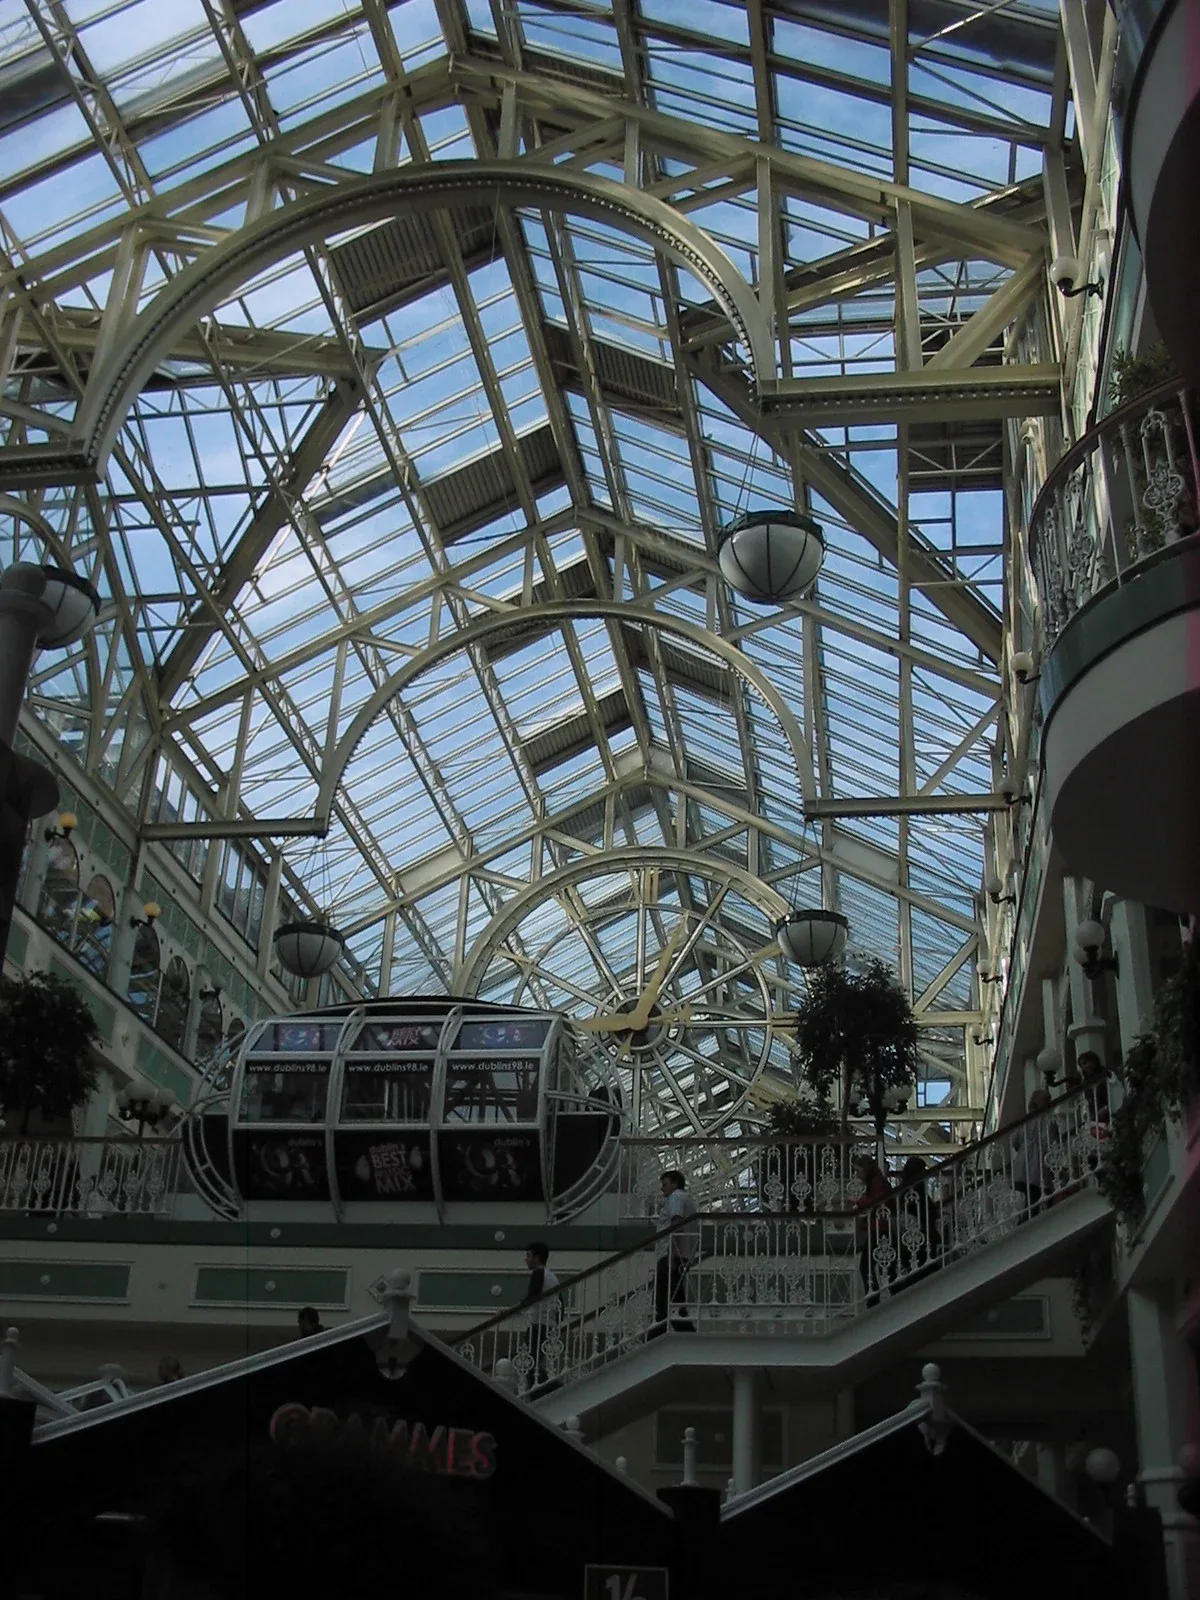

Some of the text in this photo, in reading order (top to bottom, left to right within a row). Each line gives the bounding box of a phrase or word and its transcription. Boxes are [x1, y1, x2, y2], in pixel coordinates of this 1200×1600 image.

[248, 1063, 328, 1073] www.dublins98.ie
[348, 1062, 430, 1073] www.dublins98.ie
[451, 1060, 535, 1071] www.dublins98.ie
[371, 1151, 406, 1169] BEST
[376, 1174, 417, 1195] MIX
